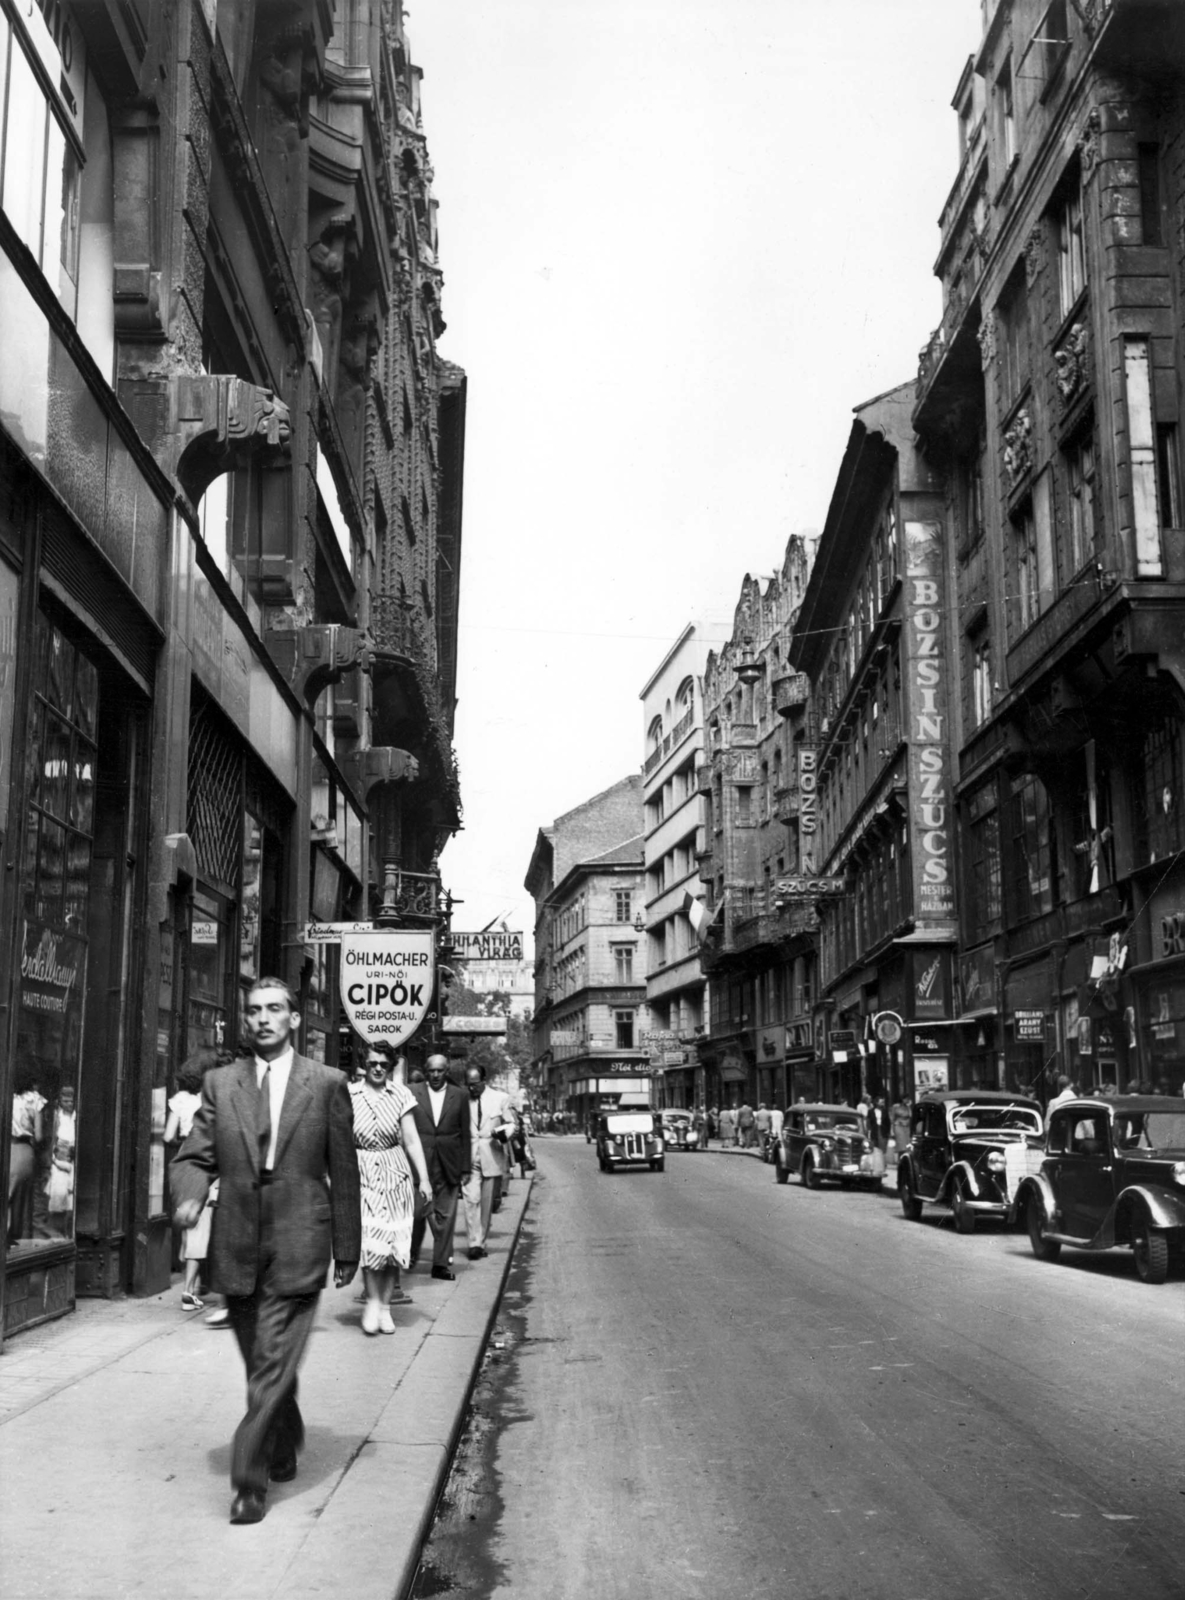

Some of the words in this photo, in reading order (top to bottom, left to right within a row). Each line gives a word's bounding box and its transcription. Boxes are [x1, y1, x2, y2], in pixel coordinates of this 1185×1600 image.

[912, 580, 943, 740] BOZSIN
[800, 752, 818, 876] BOZSIN
[920, 884, 953, 896] MESTER
[452, 935, 521, 948] HILANTHIA
[345, 949, 429, 967] ÖHLMACHER
[22, 990, 41, 1008] HAUTE
[40, 994, 64, 1013] COUTURE
[354, 1008, 376, 1021] RÉGI
[367, 1024, 402, 1034] SAROK
[1018, 1019, 1041, 1027] ARANY
